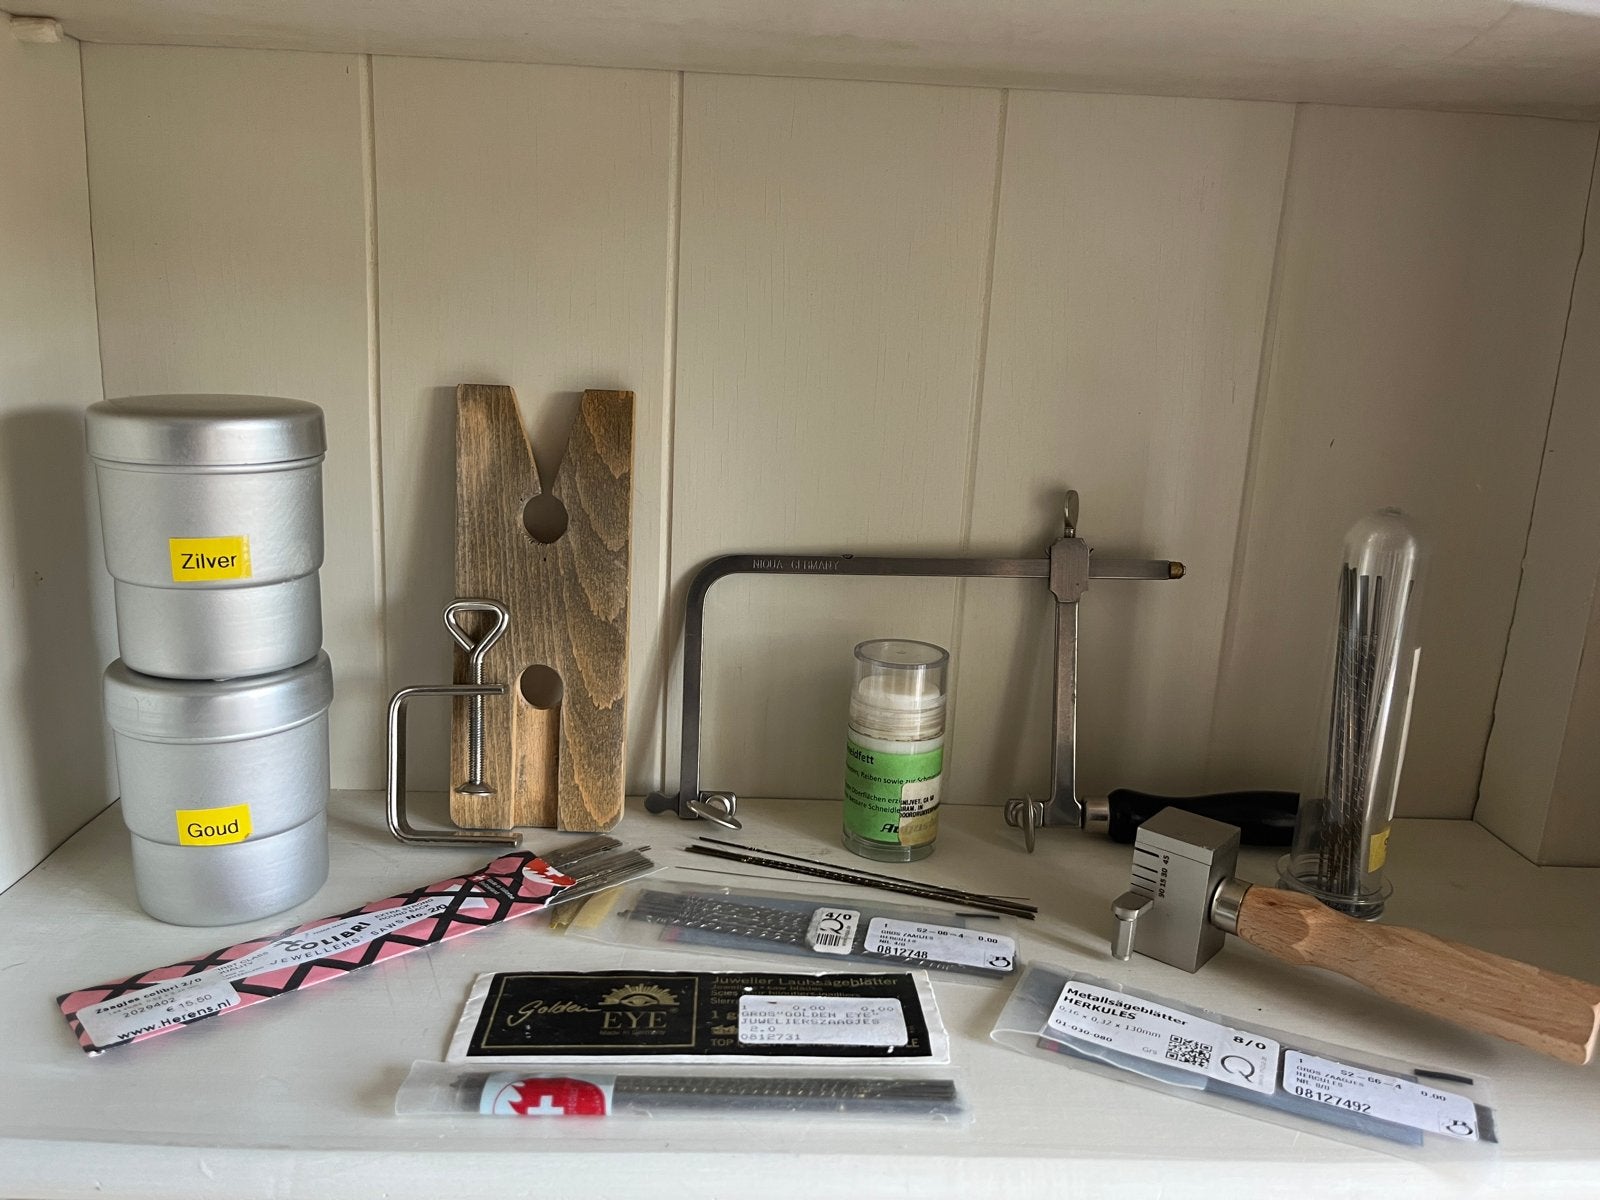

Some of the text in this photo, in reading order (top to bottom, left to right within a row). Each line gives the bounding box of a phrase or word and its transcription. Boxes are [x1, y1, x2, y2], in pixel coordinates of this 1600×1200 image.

[181, 553, 237, 569] Zilver
[791, 559, 840, 570] GERMANY
[883, 777, 903, 785] sowie
[187, 819, 239, 838] Goud
[1163, 855, 1169, 865] 45
[402, 898, 434, 911] STRONG
[825, 912, 852, 921] 4/0
[370, 920, 404, 936] SAWS
[285, 921, 371, 952] COLIBRI
[877, 944, 928, 959] 0812748
[712, 975, 898, 988] Juwelier Laubsägeblätter
[95, 997, 140, 1014] Zaagjes
[143, 984, 179, 999] colibri
[181, 977, 202, 987] 2/0
[122, 996, 175, 1019] 2029402
[506, 999, 601, 1027] Golden
[1063, 995, 1137, 1020] HERKULES
[1066, 987, 1188, 1026] Metallsägeblätter
[116, 998, 231, 1040] www.Herens.nl
[600, 1011, 668, 1028] EYE
[741, 1033, 801, 1041] 0812731
[1125, 1023, 1162, 1039] 130mm
[710, 1038, 734, 1047] TOP
[1232, 1035, 1268, 1051] 8/0
[1295, 1085, 1371, 1114] 08127492
